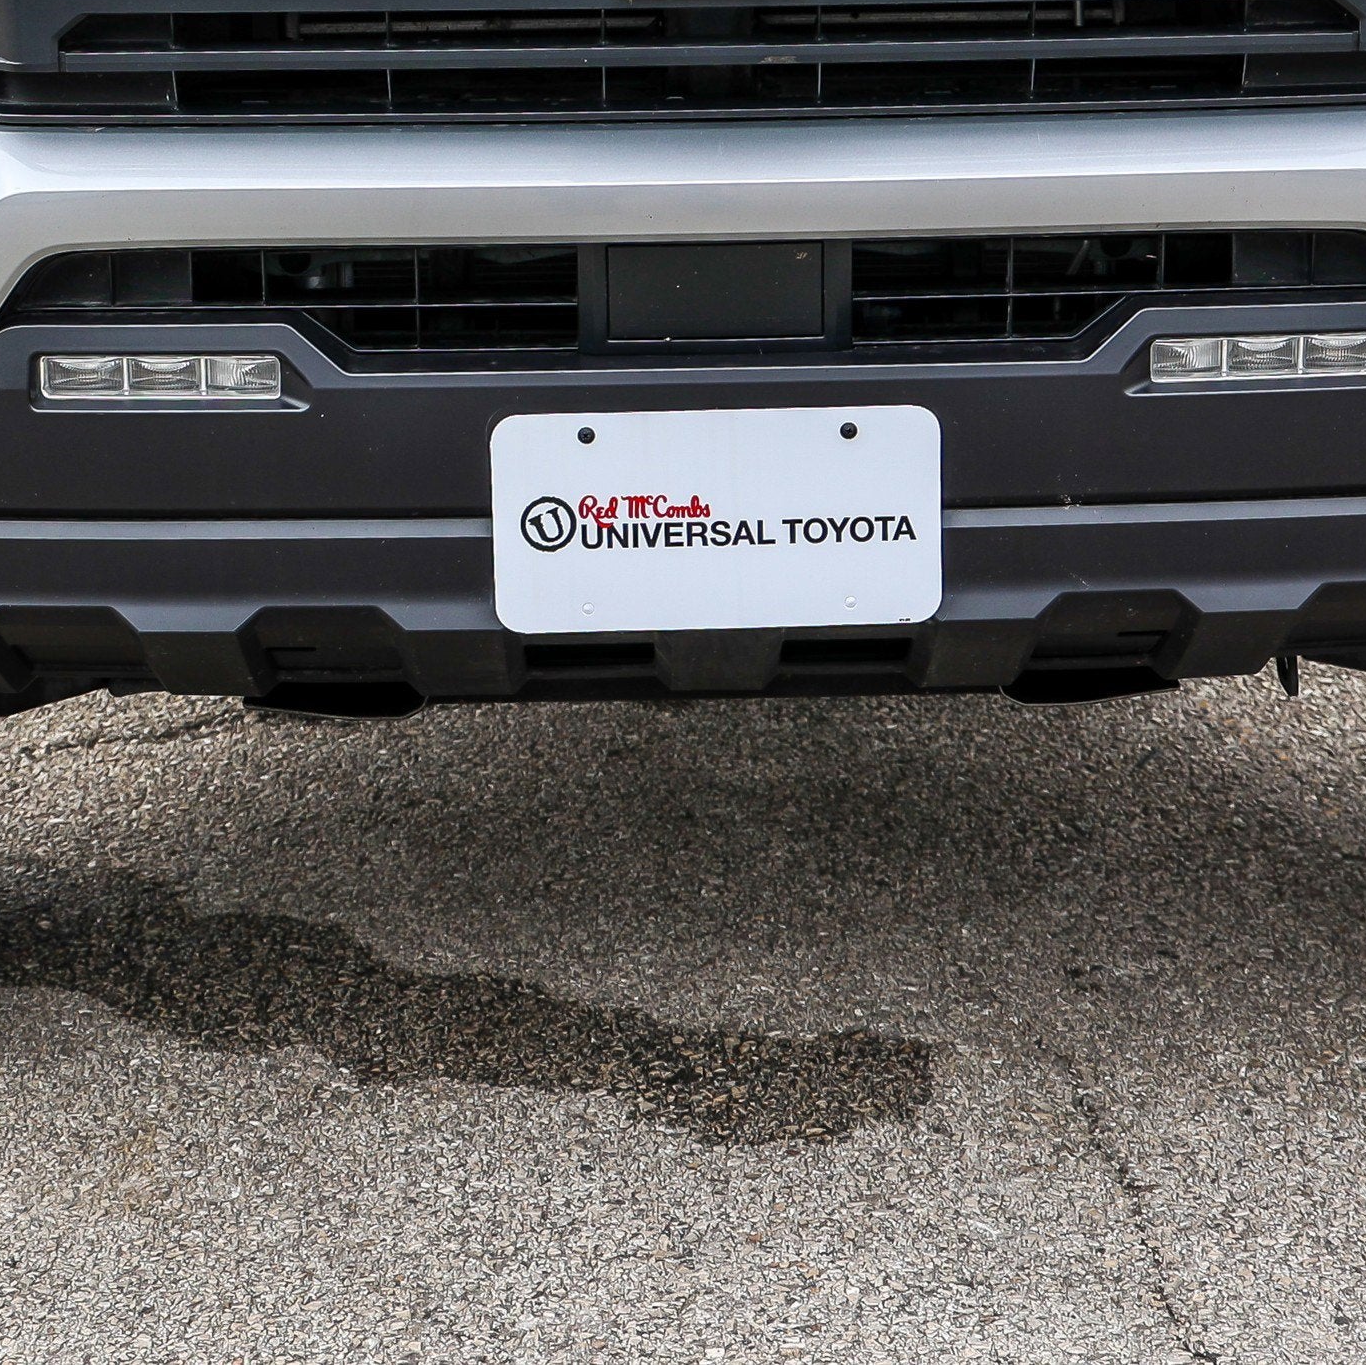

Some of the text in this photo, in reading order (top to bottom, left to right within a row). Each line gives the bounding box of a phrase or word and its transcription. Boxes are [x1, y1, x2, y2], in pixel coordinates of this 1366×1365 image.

[578, 494, 711, 529] Red McCombs
[581, 515, 917, 550] UNIVERSAL TOYOTA
